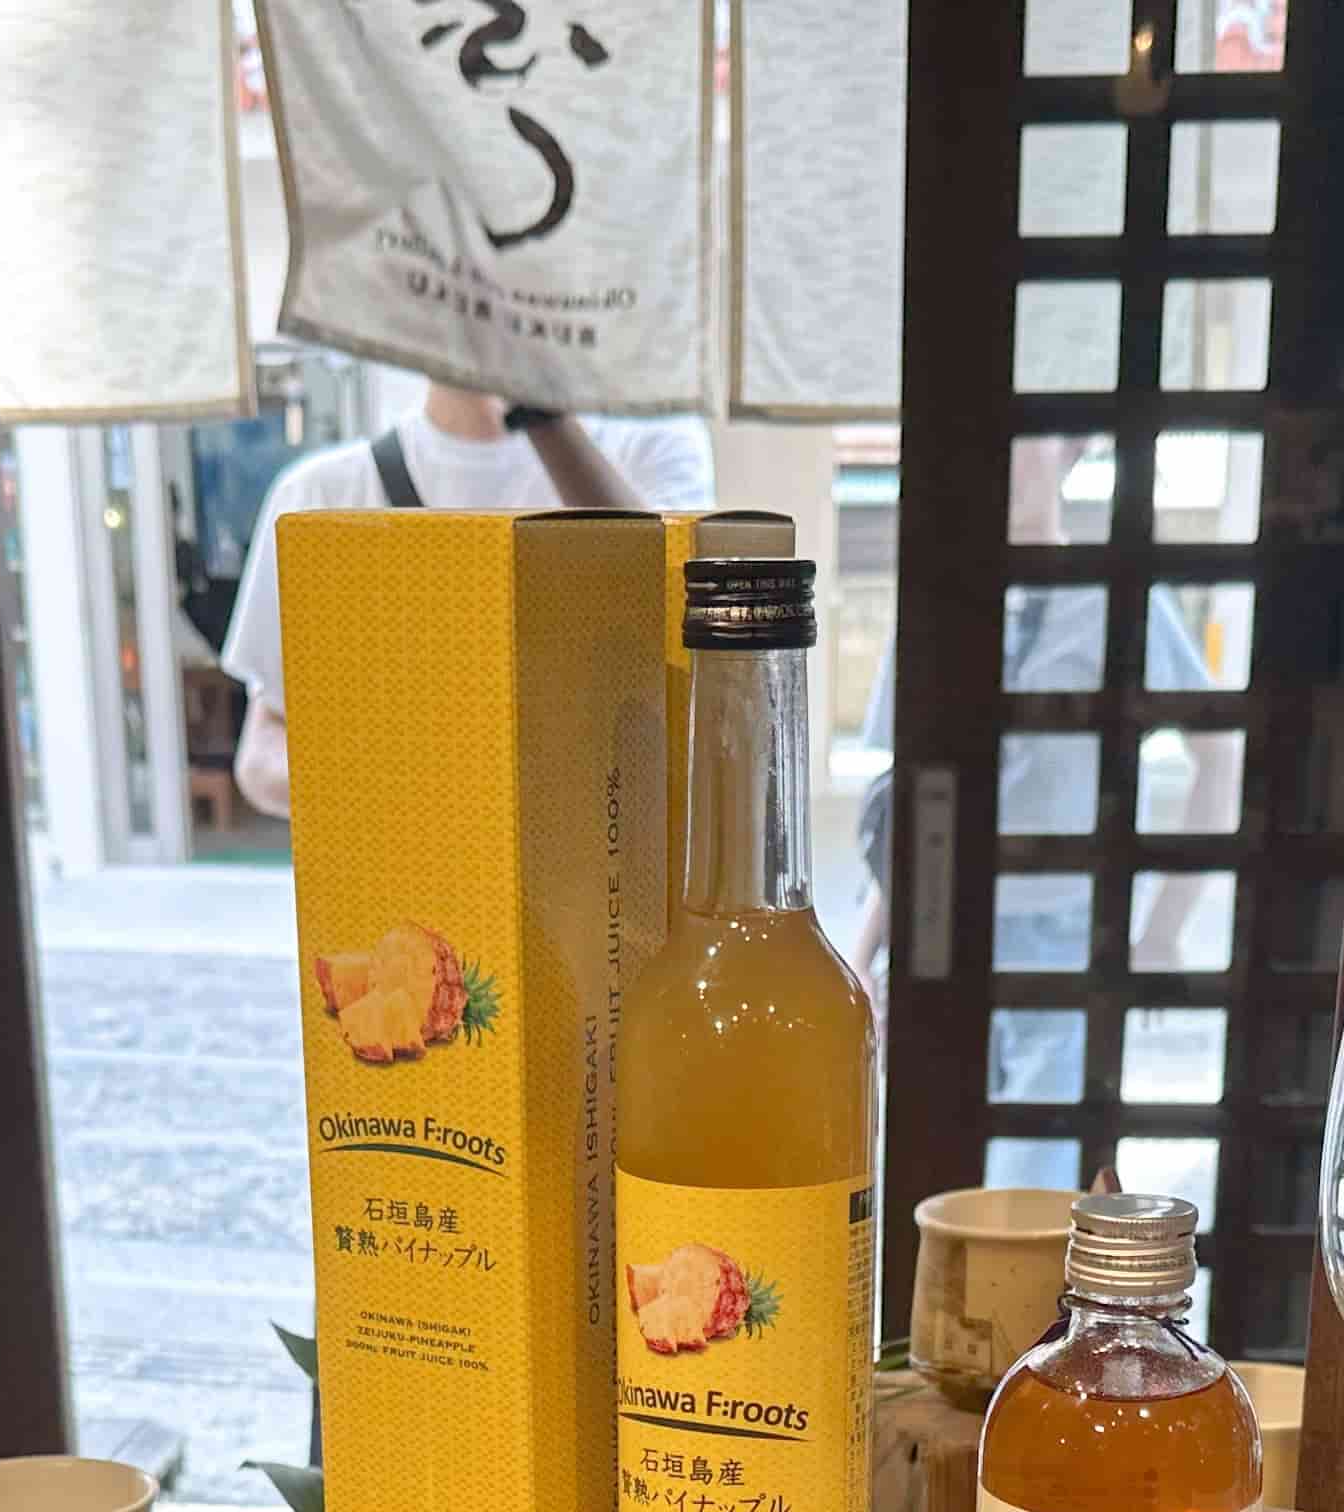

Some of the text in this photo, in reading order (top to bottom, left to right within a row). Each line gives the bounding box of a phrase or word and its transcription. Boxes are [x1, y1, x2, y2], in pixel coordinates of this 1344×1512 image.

[606, 766, 622, 858] 100%
[607, 876, 622, 976] JUICE
[318, 1112, 506, 1168] Okinawa F:roots
[585, 1014, 602, 1327] OKINAWA ISHIGAKI
[363, 1198, 462, 1236] 石垣島産
[333, 1225, 498, 1274] 贅熟パイナップル
[359, 1311, 472, 1337] OKINAWA ISHIGAKI
[383, 1346, 417, 1360] FRUIT
[420, 1353, 455, 1366] JUICE
[458, 1359, 489, 1372] 100%
[617, 1377, 809, 1433] kinawa F:roots
[639, 1447, 745, 1488] 石垣島産
